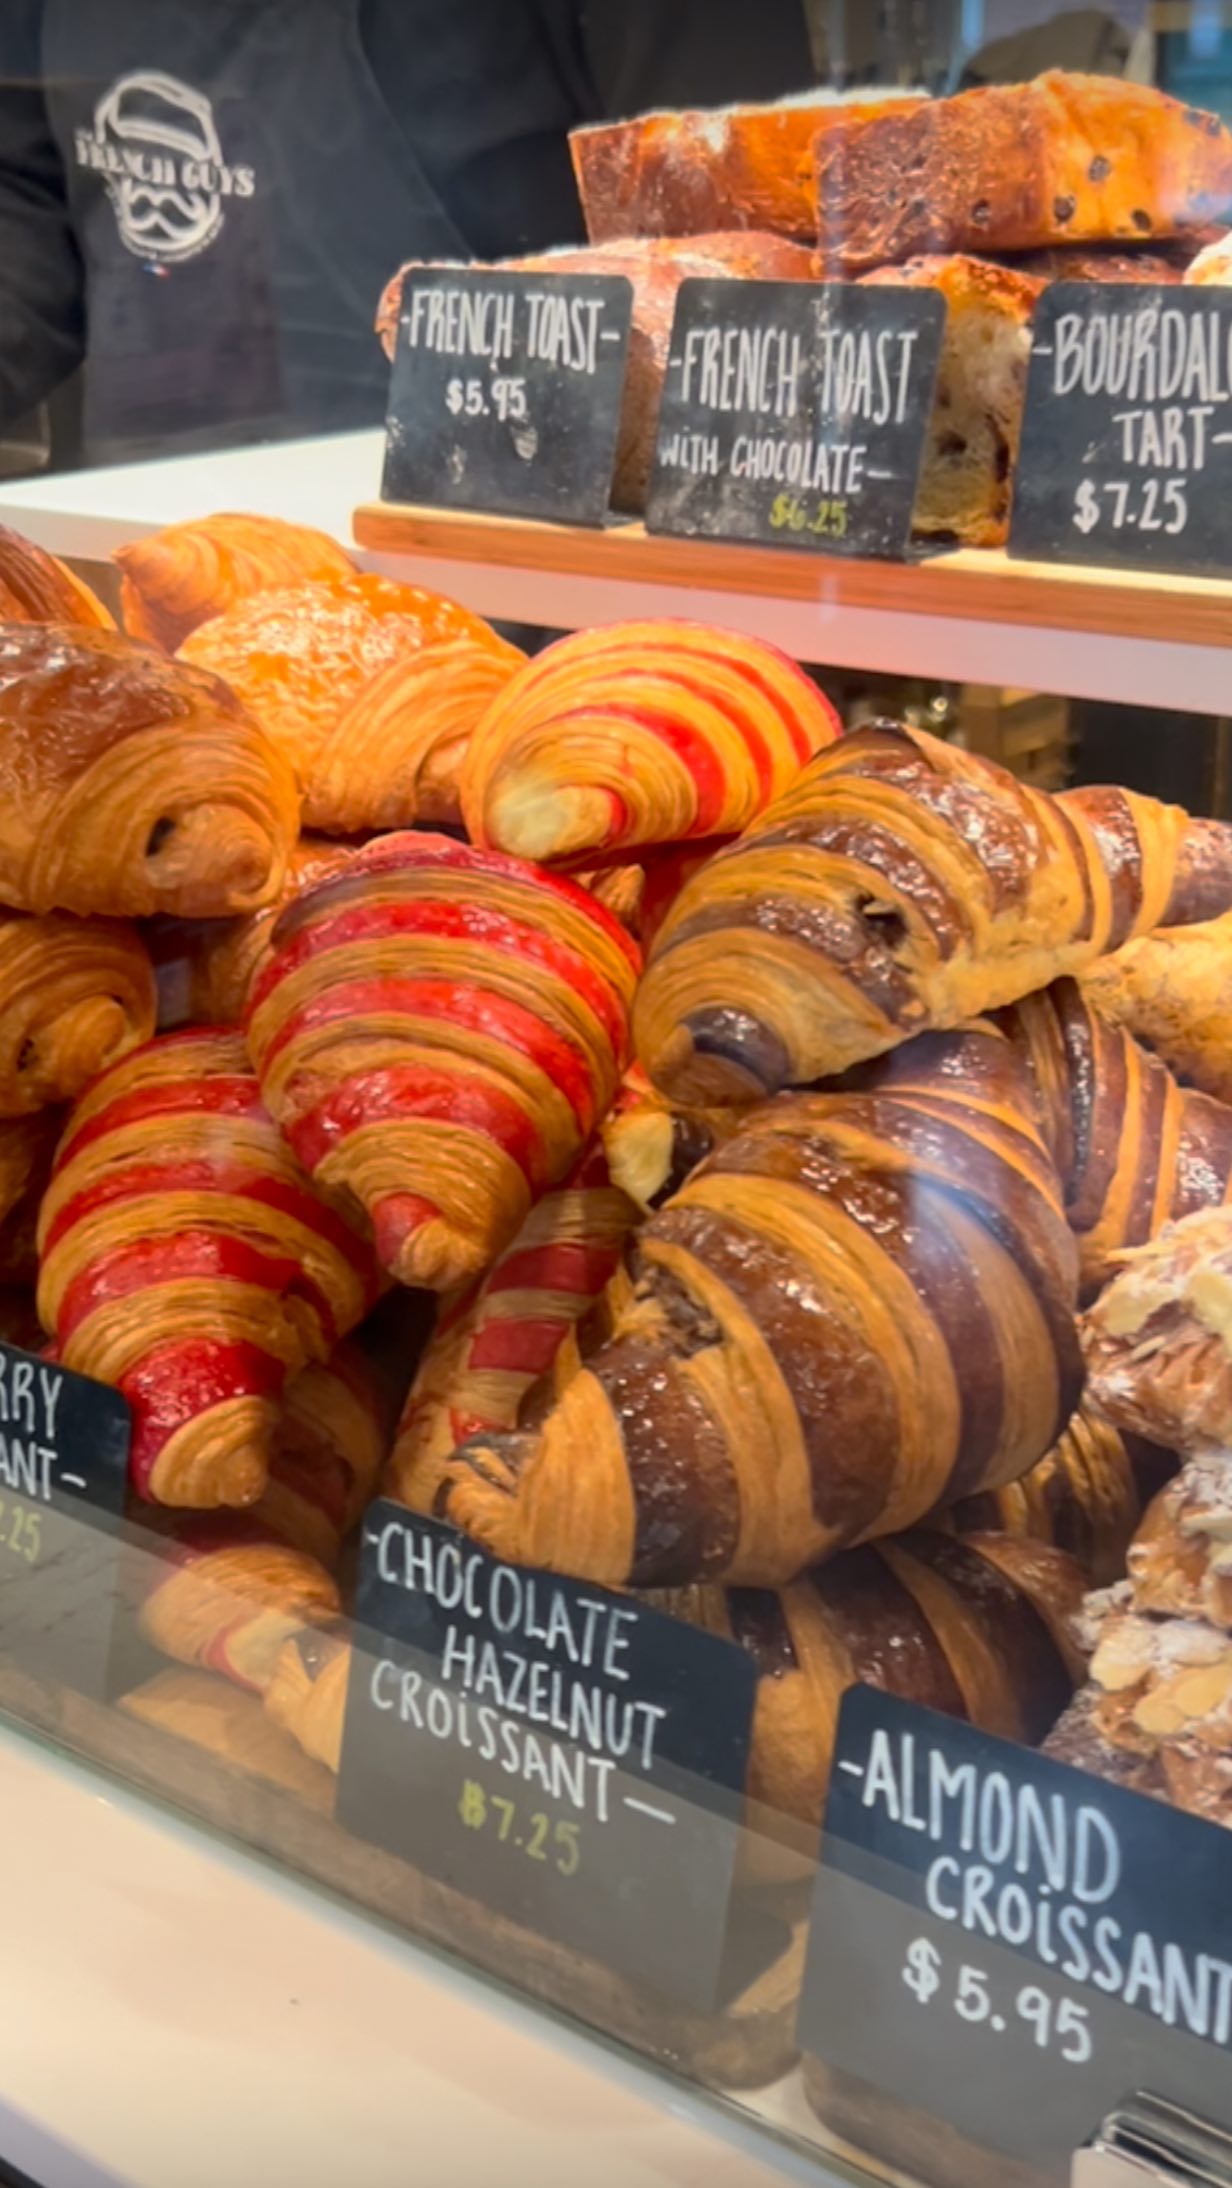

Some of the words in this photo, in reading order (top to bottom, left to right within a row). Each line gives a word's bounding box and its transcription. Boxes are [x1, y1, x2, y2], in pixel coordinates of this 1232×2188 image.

[181, 160, 256, 197] GUYS
[445, 378, 527, 421] $5.95
[818, 328, 919, 425] TOAST
[768, 494, 849, 538] $6.25
[1072, 478, 1189, 534] $7.25
[442, 1625, 666, 1770] HAZELNUT
